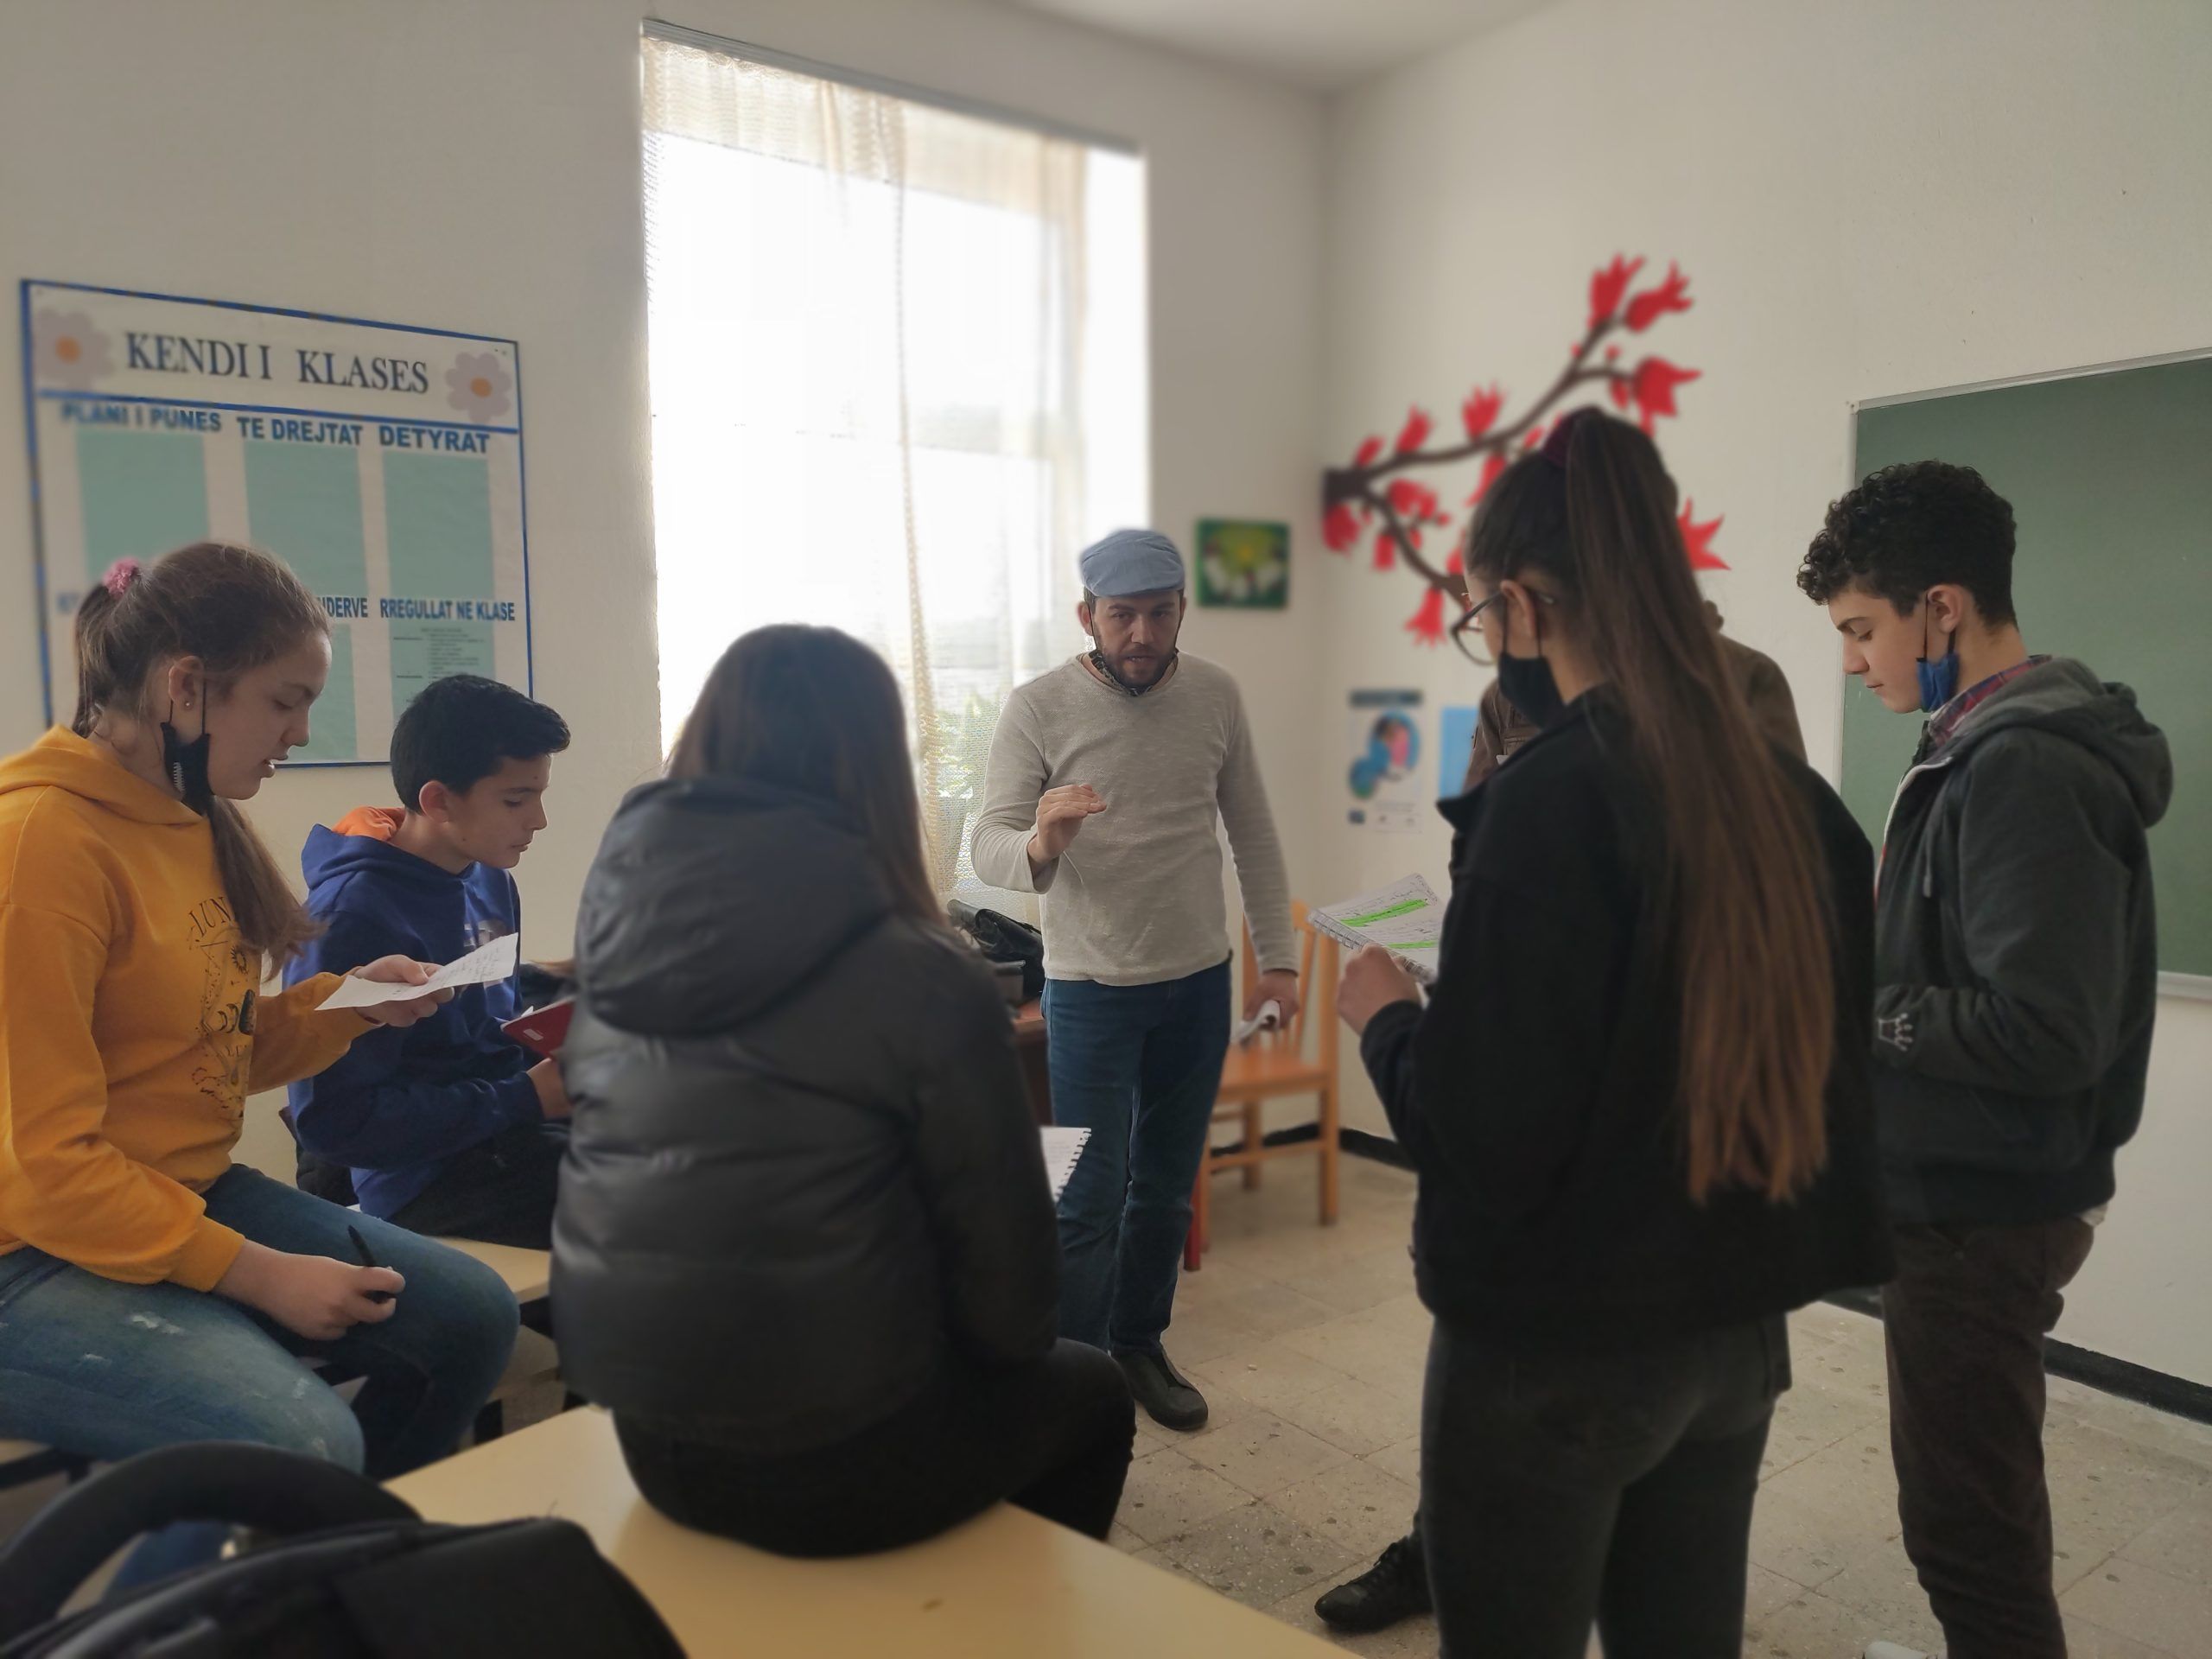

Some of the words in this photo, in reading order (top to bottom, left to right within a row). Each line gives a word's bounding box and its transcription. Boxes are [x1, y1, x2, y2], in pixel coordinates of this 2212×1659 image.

[296, 349, 429, 394] KLASES
[61, 402, 129, 425] PLANI
[135, 406, 143, 426] I
[150, 407, 222, 431] PUNES
[237, 416, 264, 439] TE
[271, 419, 363, 445] DREJTAT
[378, 426, 490, 453] DETYRAT
[380, 598, 453, 619] RREGULLAT
[456, 601, 473, 620] NE
[477, 601, 515, 621] KLASE
